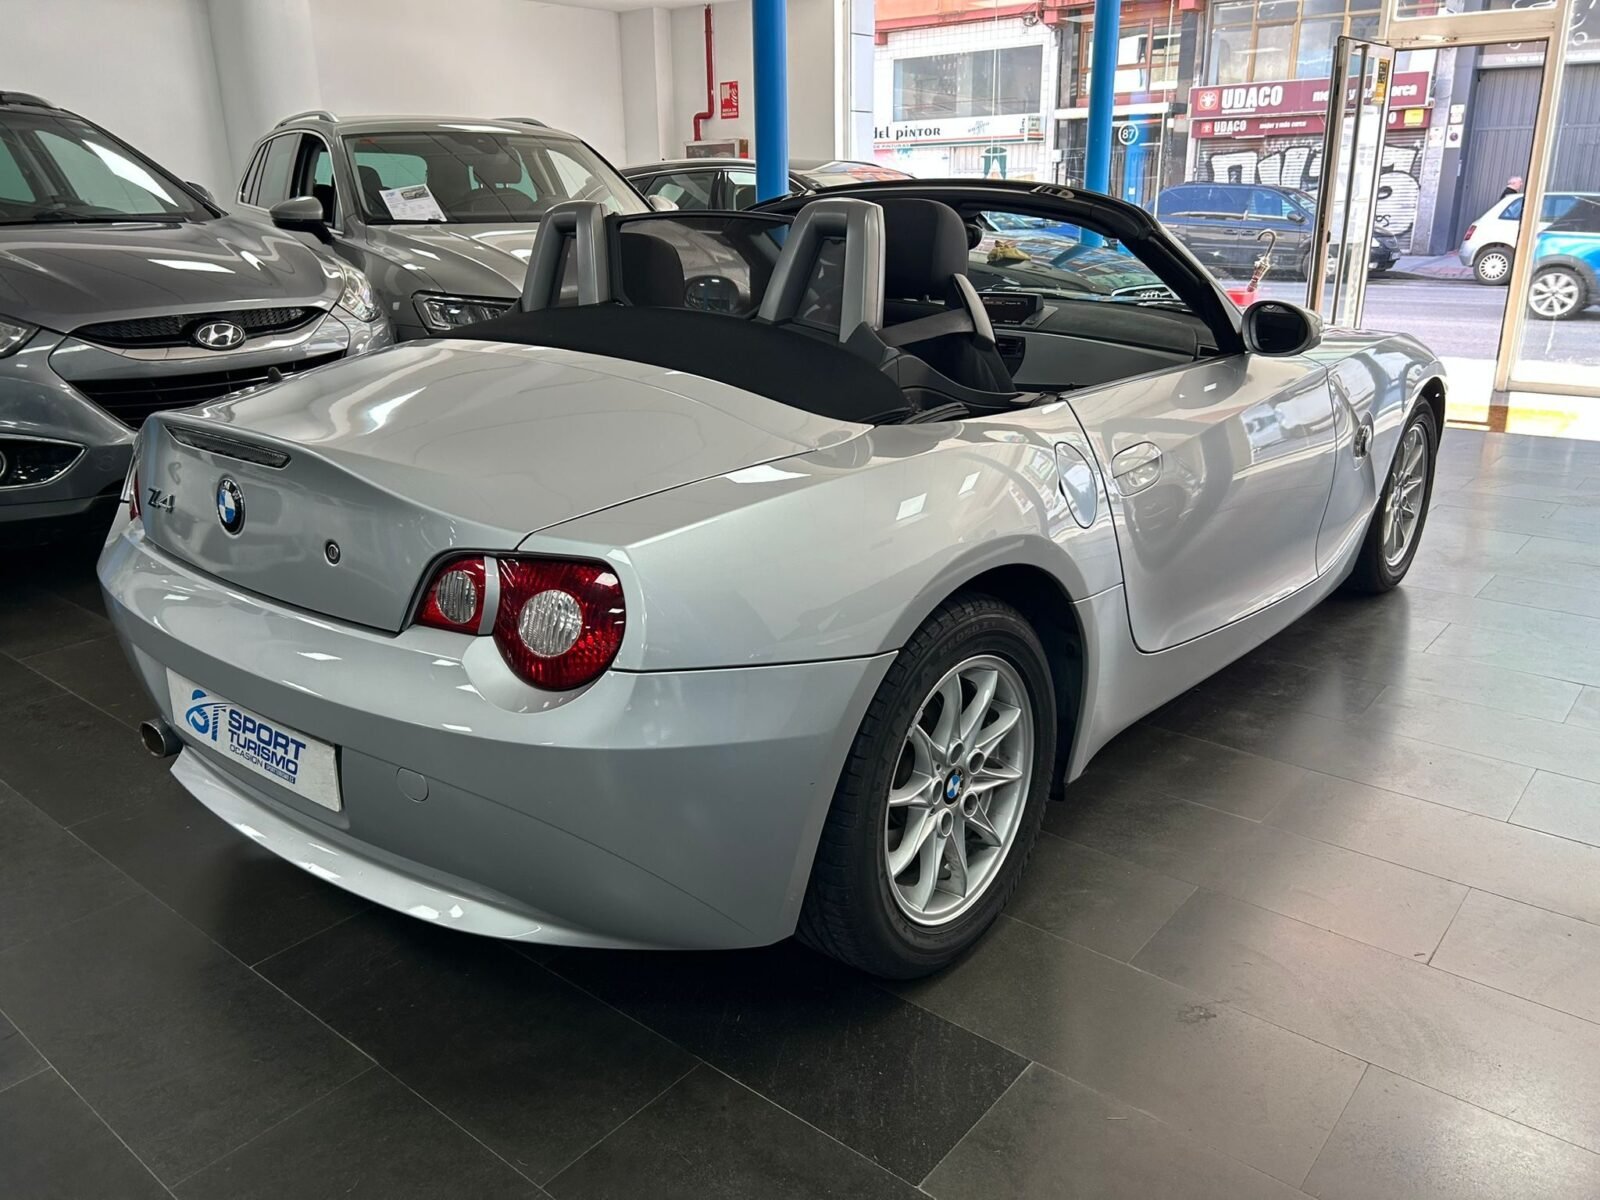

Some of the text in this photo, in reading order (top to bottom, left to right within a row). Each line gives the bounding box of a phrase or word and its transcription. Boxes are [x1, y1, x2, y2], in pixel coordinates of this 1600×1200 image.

[1221, 85, 1284, 109] UDACO
[1391, 84, 1418, 97] erca
[1122, 128, 1135, 140] 87
[1213, 119, 1247, 133] UDACO
[147, 487, 176, 514] Z4
[227, 708, 307, 761] SPORT
[227, 728, 299, 776] TURISMO
[229, 743, 264, 768] OCASION
